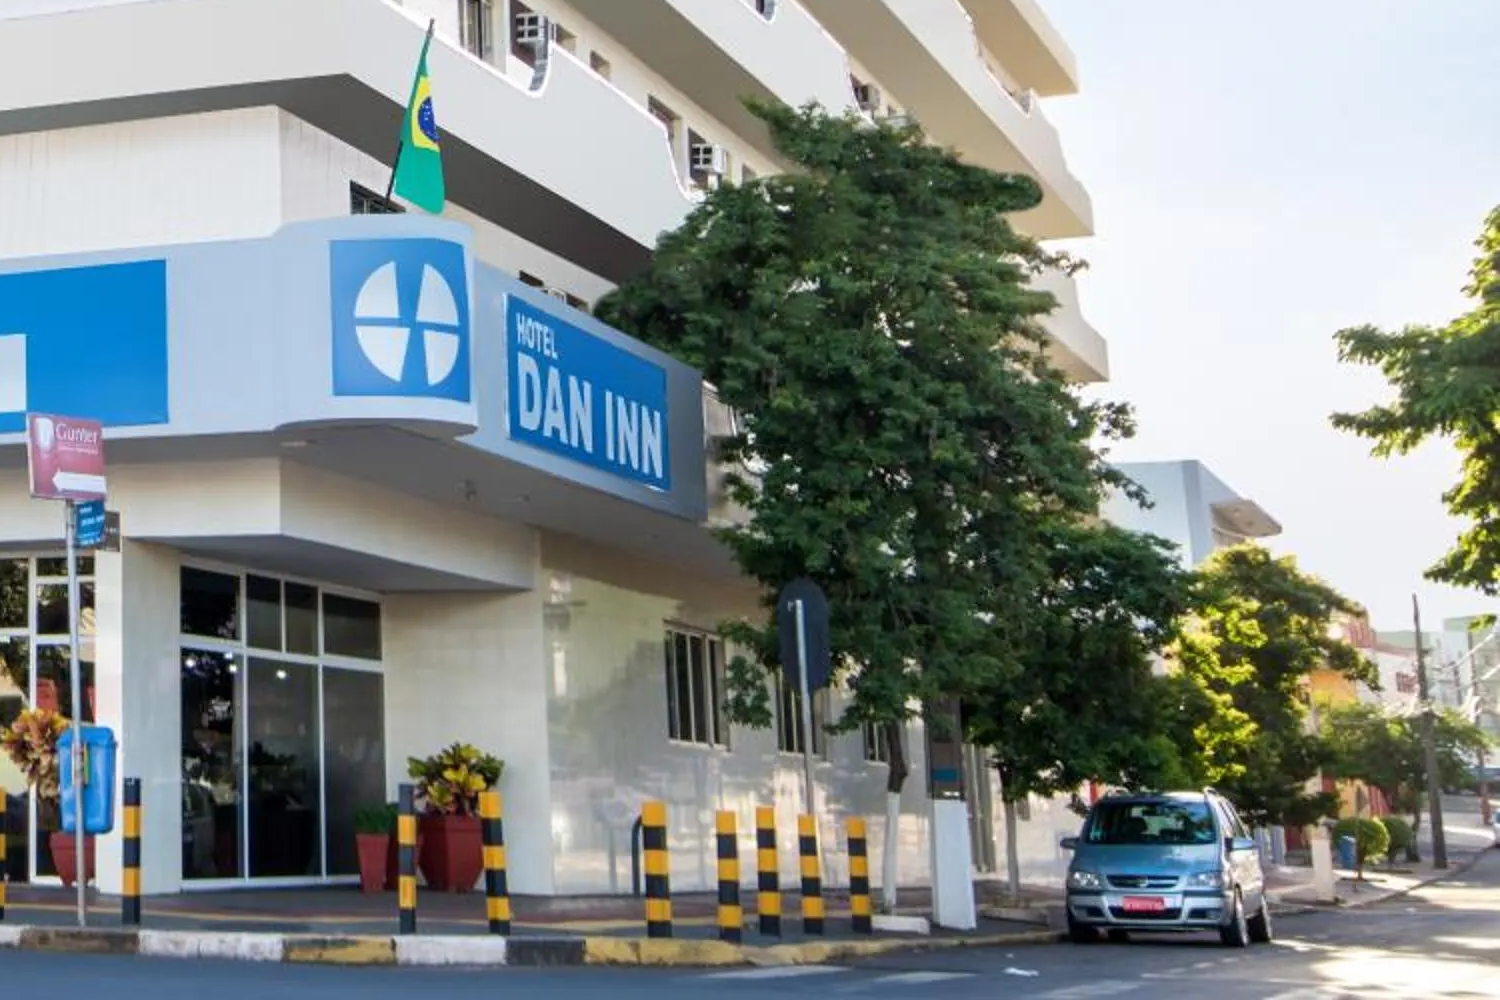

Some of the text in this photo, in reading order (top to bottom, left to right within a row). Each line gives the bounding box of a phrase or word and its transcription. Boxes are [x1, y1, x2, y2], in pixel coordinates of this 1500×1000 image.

[516, 313, 558, 359] HOTEL
[518, 352, 662, 478] DAN INN
